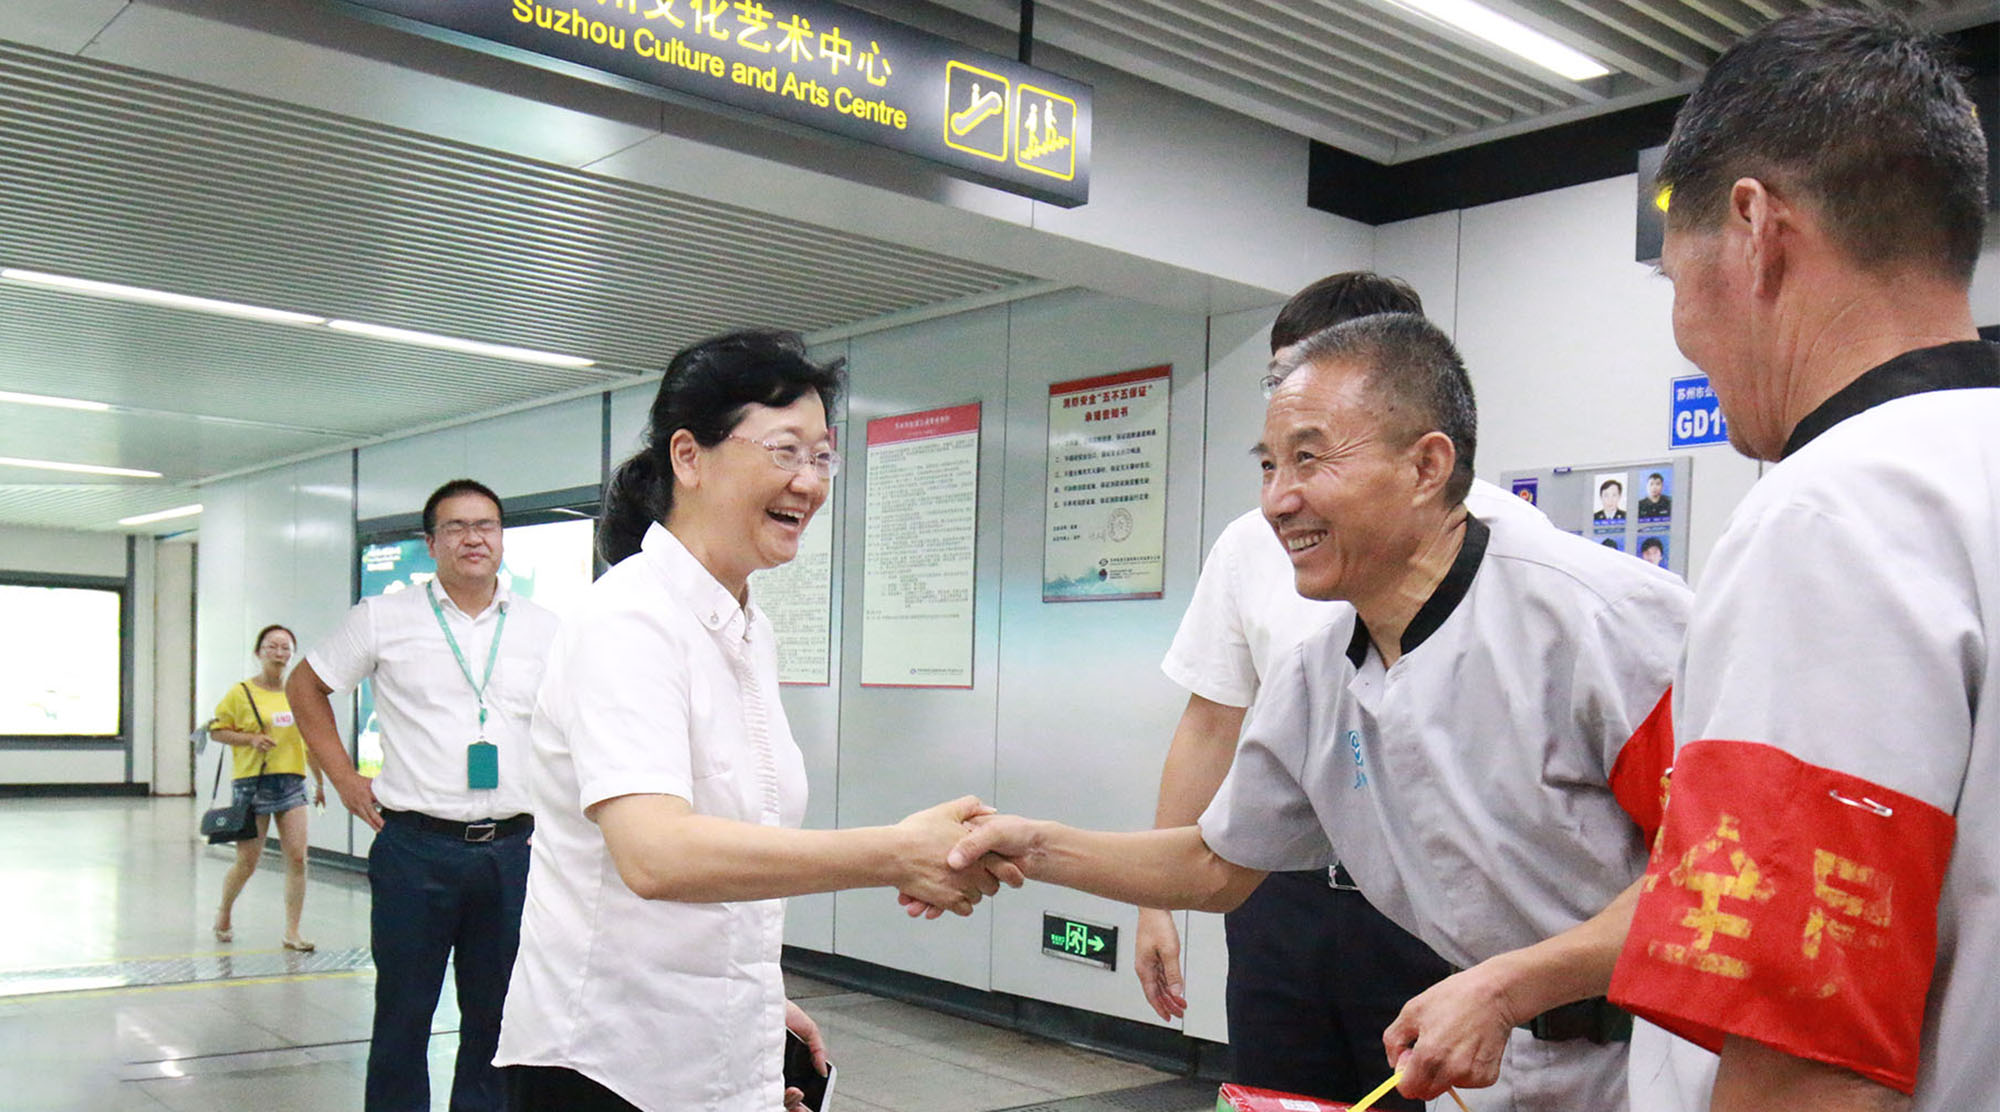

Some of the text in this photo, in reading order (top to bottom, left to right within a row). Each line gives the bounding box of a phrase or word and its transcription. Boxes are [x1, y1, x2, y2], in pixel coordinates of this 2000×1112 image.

[512, 0, 908, 131] Suzhou Culture and Arts Centre
[1677, 385, 1717, 401] 苏州市公
[1676, 406, 1727, 440] GD1
